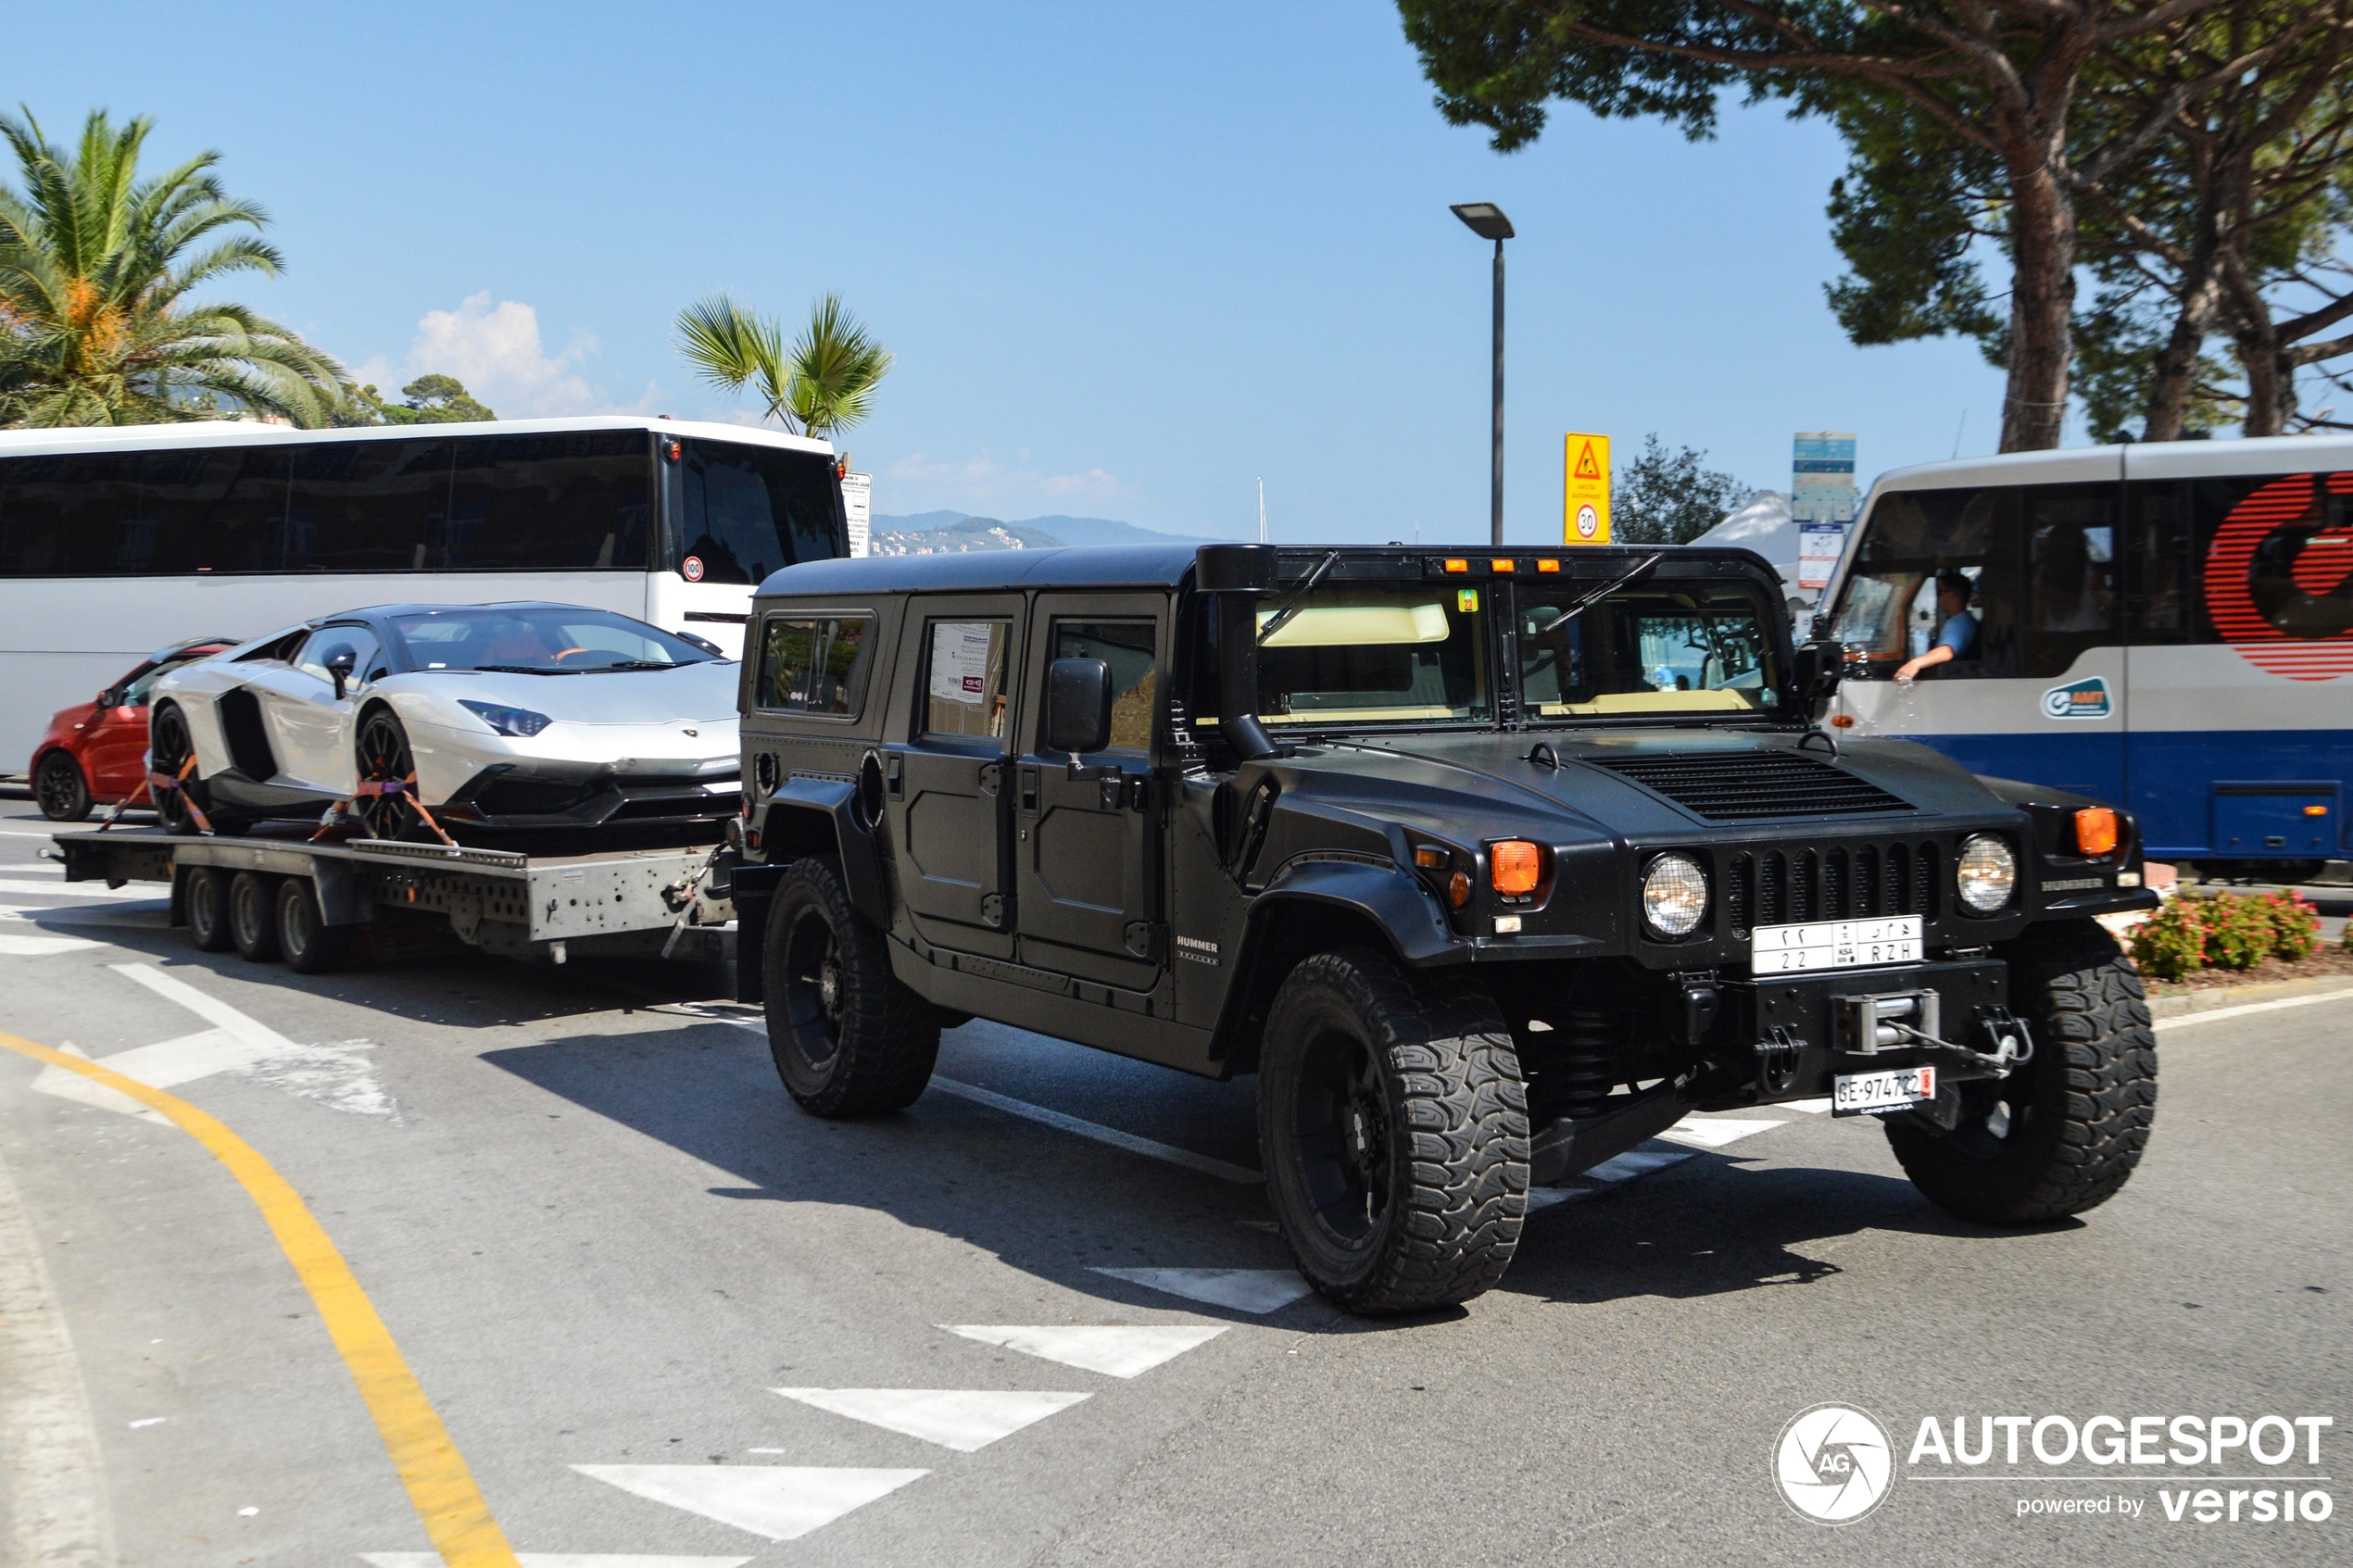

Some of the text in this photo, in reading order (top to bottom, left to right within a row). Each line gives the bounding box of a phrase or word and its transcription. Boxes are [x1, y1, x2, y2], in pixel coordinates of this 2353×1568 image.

[1580, 513, 1593, 530] 30
[687, 563, 700, 573] 100
[2071, 691, 2105, 704] AMT
[2041, 878, 2104, 892] HUMMER
[1176, 935, 1218, 953] HUMMER
